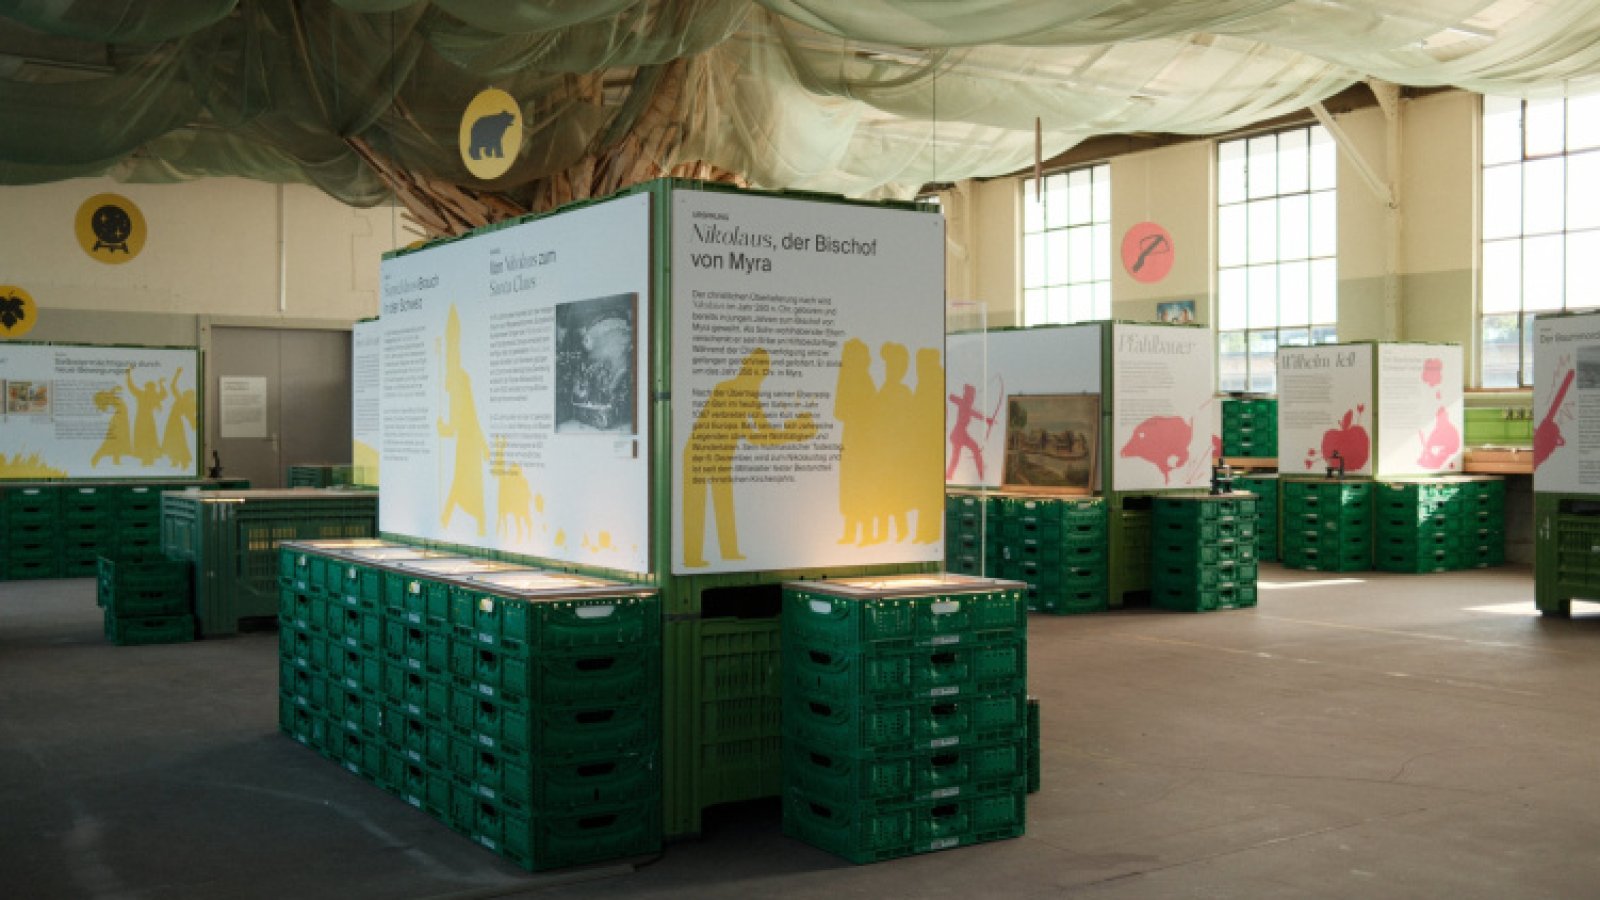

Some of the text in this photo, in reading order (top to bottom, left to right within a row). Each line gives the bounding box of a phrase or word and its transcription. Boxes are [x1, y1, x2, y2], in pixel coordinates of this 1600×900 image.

[690, 223, 877, 256] Nikolaus, der Bischof
[691, 252, 772, 274] von Myra
[1282, 353, 1331, 370] Wilhelm
